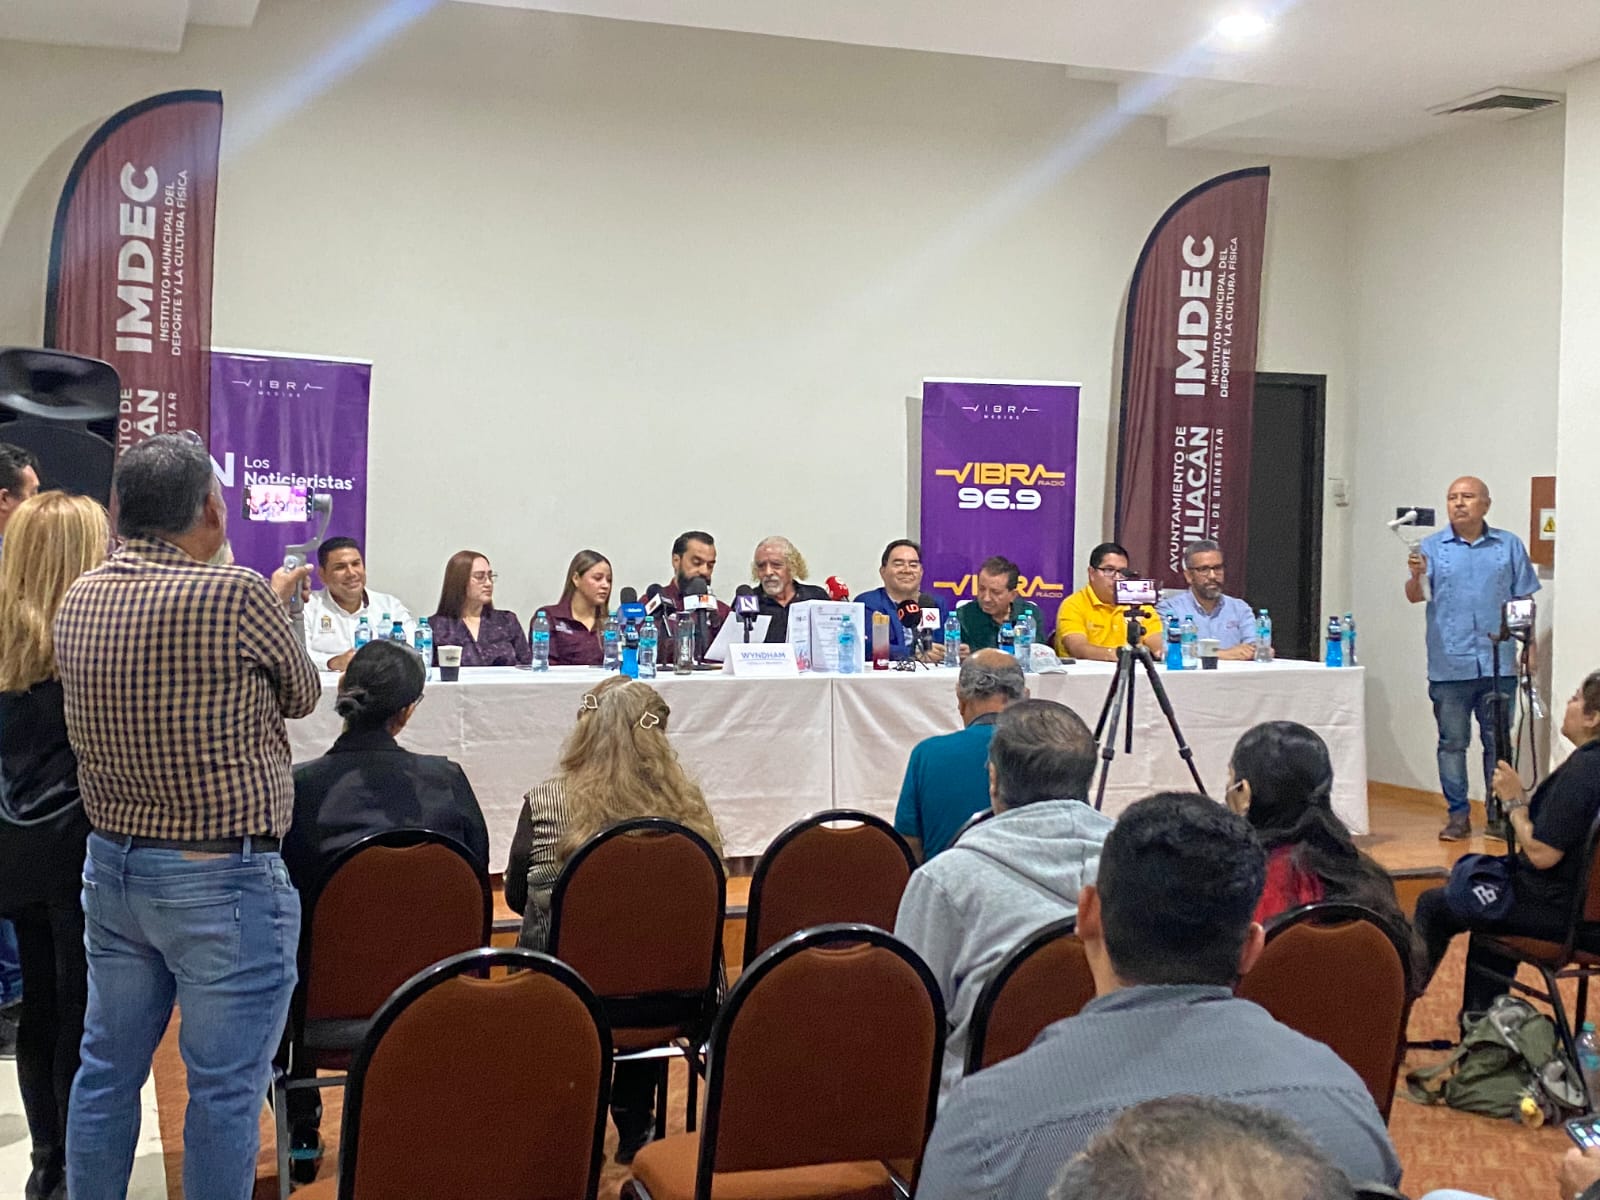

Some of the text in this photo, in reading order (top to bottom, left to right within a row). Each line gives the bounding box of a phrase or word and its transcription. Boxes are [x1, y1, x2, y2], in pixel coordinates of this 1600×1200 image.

[115, 162, 158, 353] IMDEC
[160, 182, 175, 341] INSTITUTO MUNICIPAL DEL
[171, 169, 188, 356] DEPORTE Y LA CULTURA FÍSICA
[1175, 235, 1214, 396] IMDEC
[1211, 247, 1228, 385] INSTITUTO MUNICIPAL DEL
[1220, 237, 1238, 398] DEPORTE Y LA CULTURA FÍSICA
[120, 388, 132, 413] DE
[244, 455, 270, 469] Los
[244, 471, 353, 490] Noticieristas
[935, 462, 1065, 485] VIBRA
[1213, 428, 1224, 497] BIENESTAR
[958, 487, 1042, 510] 96.9
[1169, 426, 1187, 573] AYUNTAMIENTO DE
[1182, 427, 1209, 570] LIACÁN
[1212, 503, 1220, 518] DE
[933, 574, 1064, 597] VIRA
[740, 651, 786, 659] WYNDHAM
